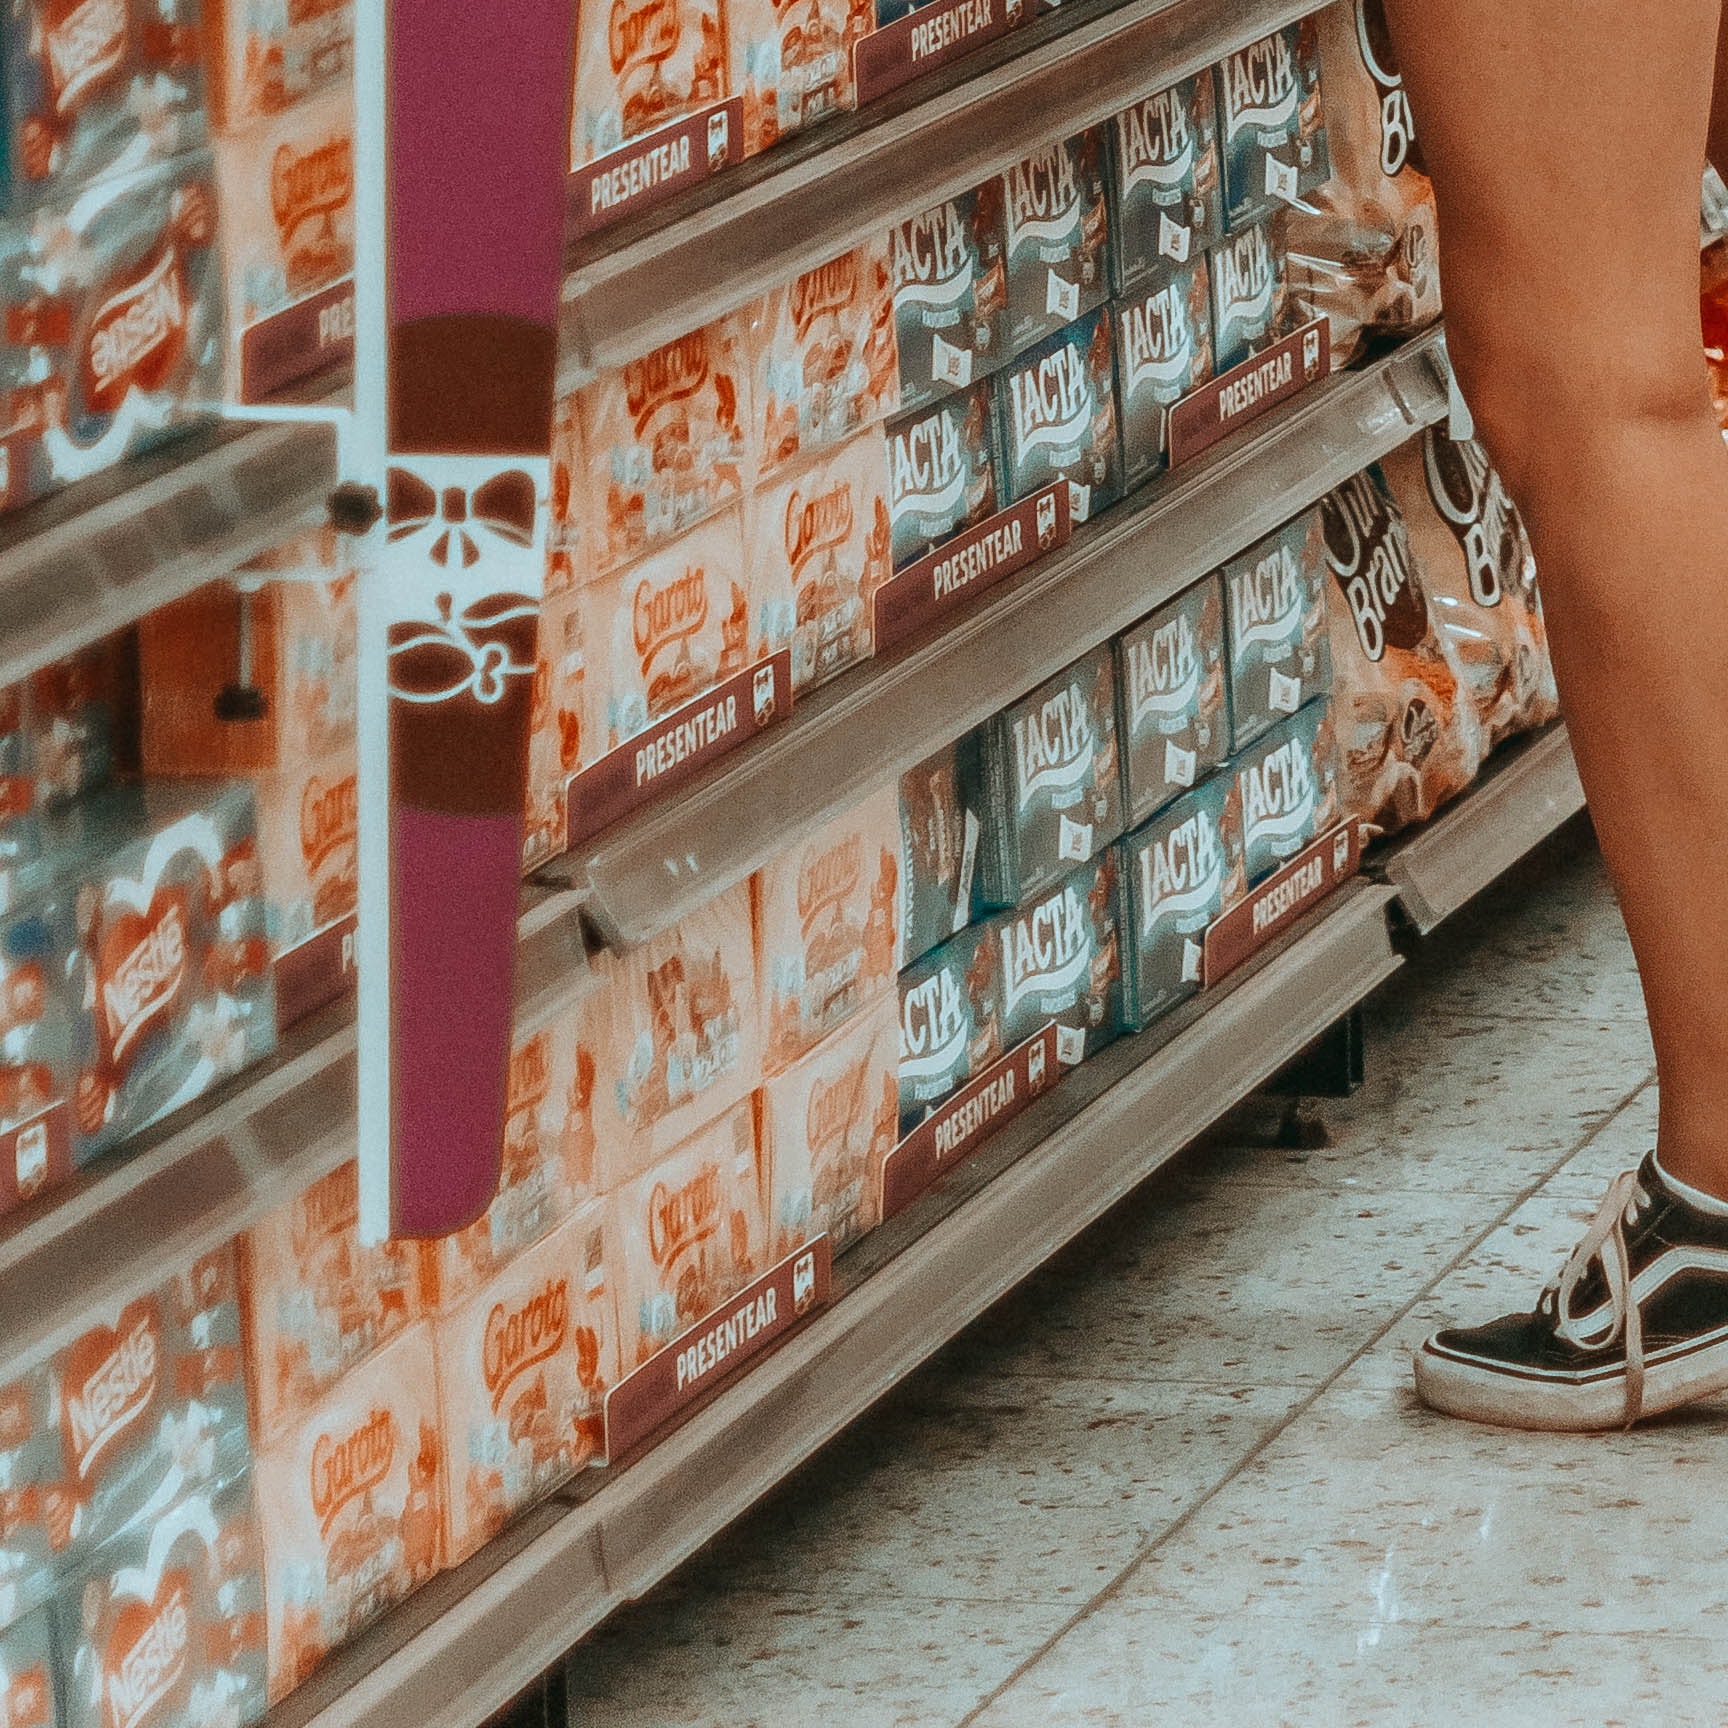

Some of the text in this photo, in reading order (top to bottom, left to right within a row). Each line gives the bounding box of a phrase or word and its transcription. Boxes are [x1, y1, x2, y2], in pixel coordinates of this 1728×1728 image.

[1219, 35, 1293, 142] LACTA
[591, 135, 690, 214] PRESENTEAR
[1116, 89, 1189, 196] LACTA
[892, 203, 968, 289] ACTA
[1213, 223, 1270, 329] LACTA
[1120, 283, 1189, 392] LACTA
[1218, 351, 1292, 423] PRESENTEAR
[1010, 342, 1087, 463] LACTA
[933, 520, 1023, 602] PRESENTEAR
[1230, 544, 1300, 660] LACTA
[1126, 612, 1197, 732] LACTA
[635, 694, 738, 788] PRESENTEAR
[1013, 681, 1093, 808] LACTA
[1240, 737, 1315, 844] LACTA
[1138, 808, 1222, 933] LACTA
[1253, 855, 1323, 936] PRESENTEAR
[998, 885, 1086, 1012] LACTA
[898, 966, 965, 1057] CTA
[934, 1072, 1016, 1160] PRESENTEAR
[676, 1287, 777, 1393] PRESENTEAR
